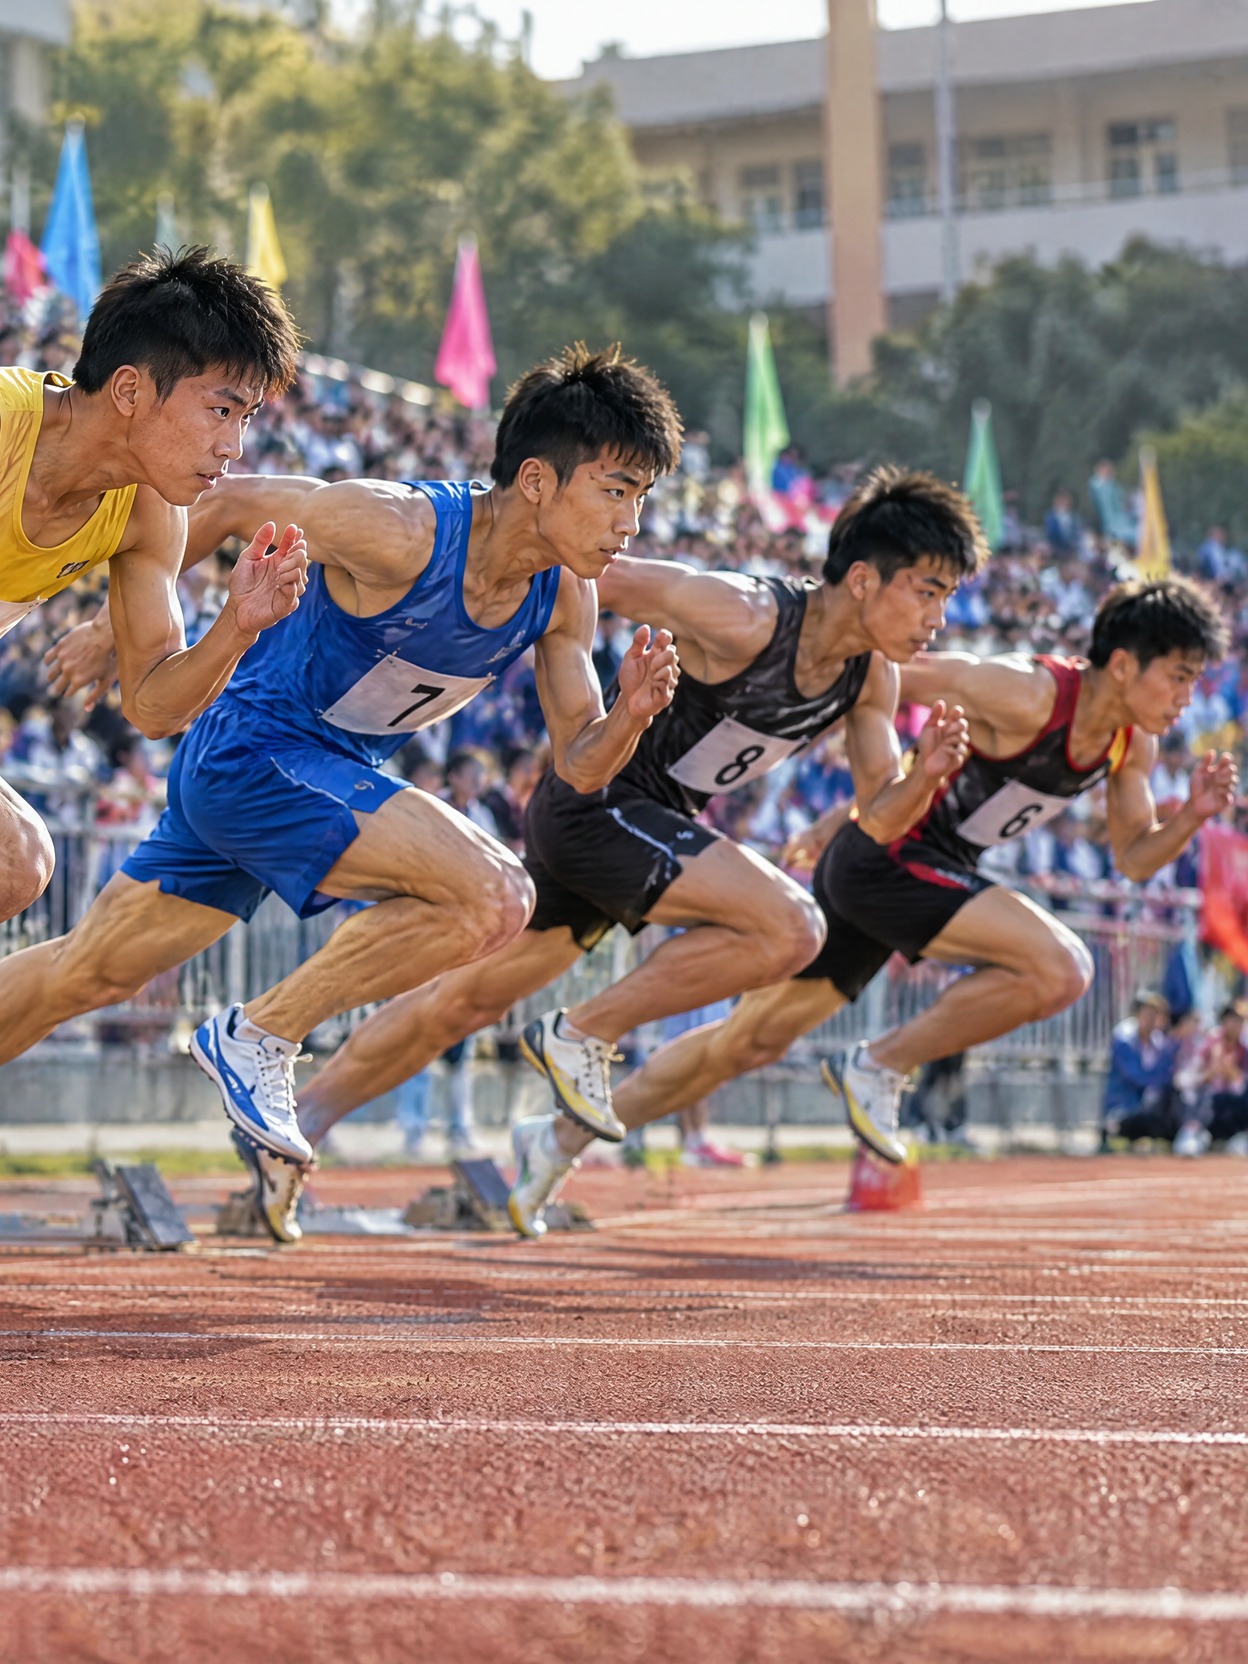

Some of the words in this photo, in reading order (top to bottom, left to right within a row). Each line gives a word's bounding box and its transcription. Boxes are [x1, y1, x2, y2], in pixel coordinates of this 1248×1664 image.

[387, 683, 446, 727] 7
[715, 744, 765, 785] 8
[998, 803, 1043, 838] 6
